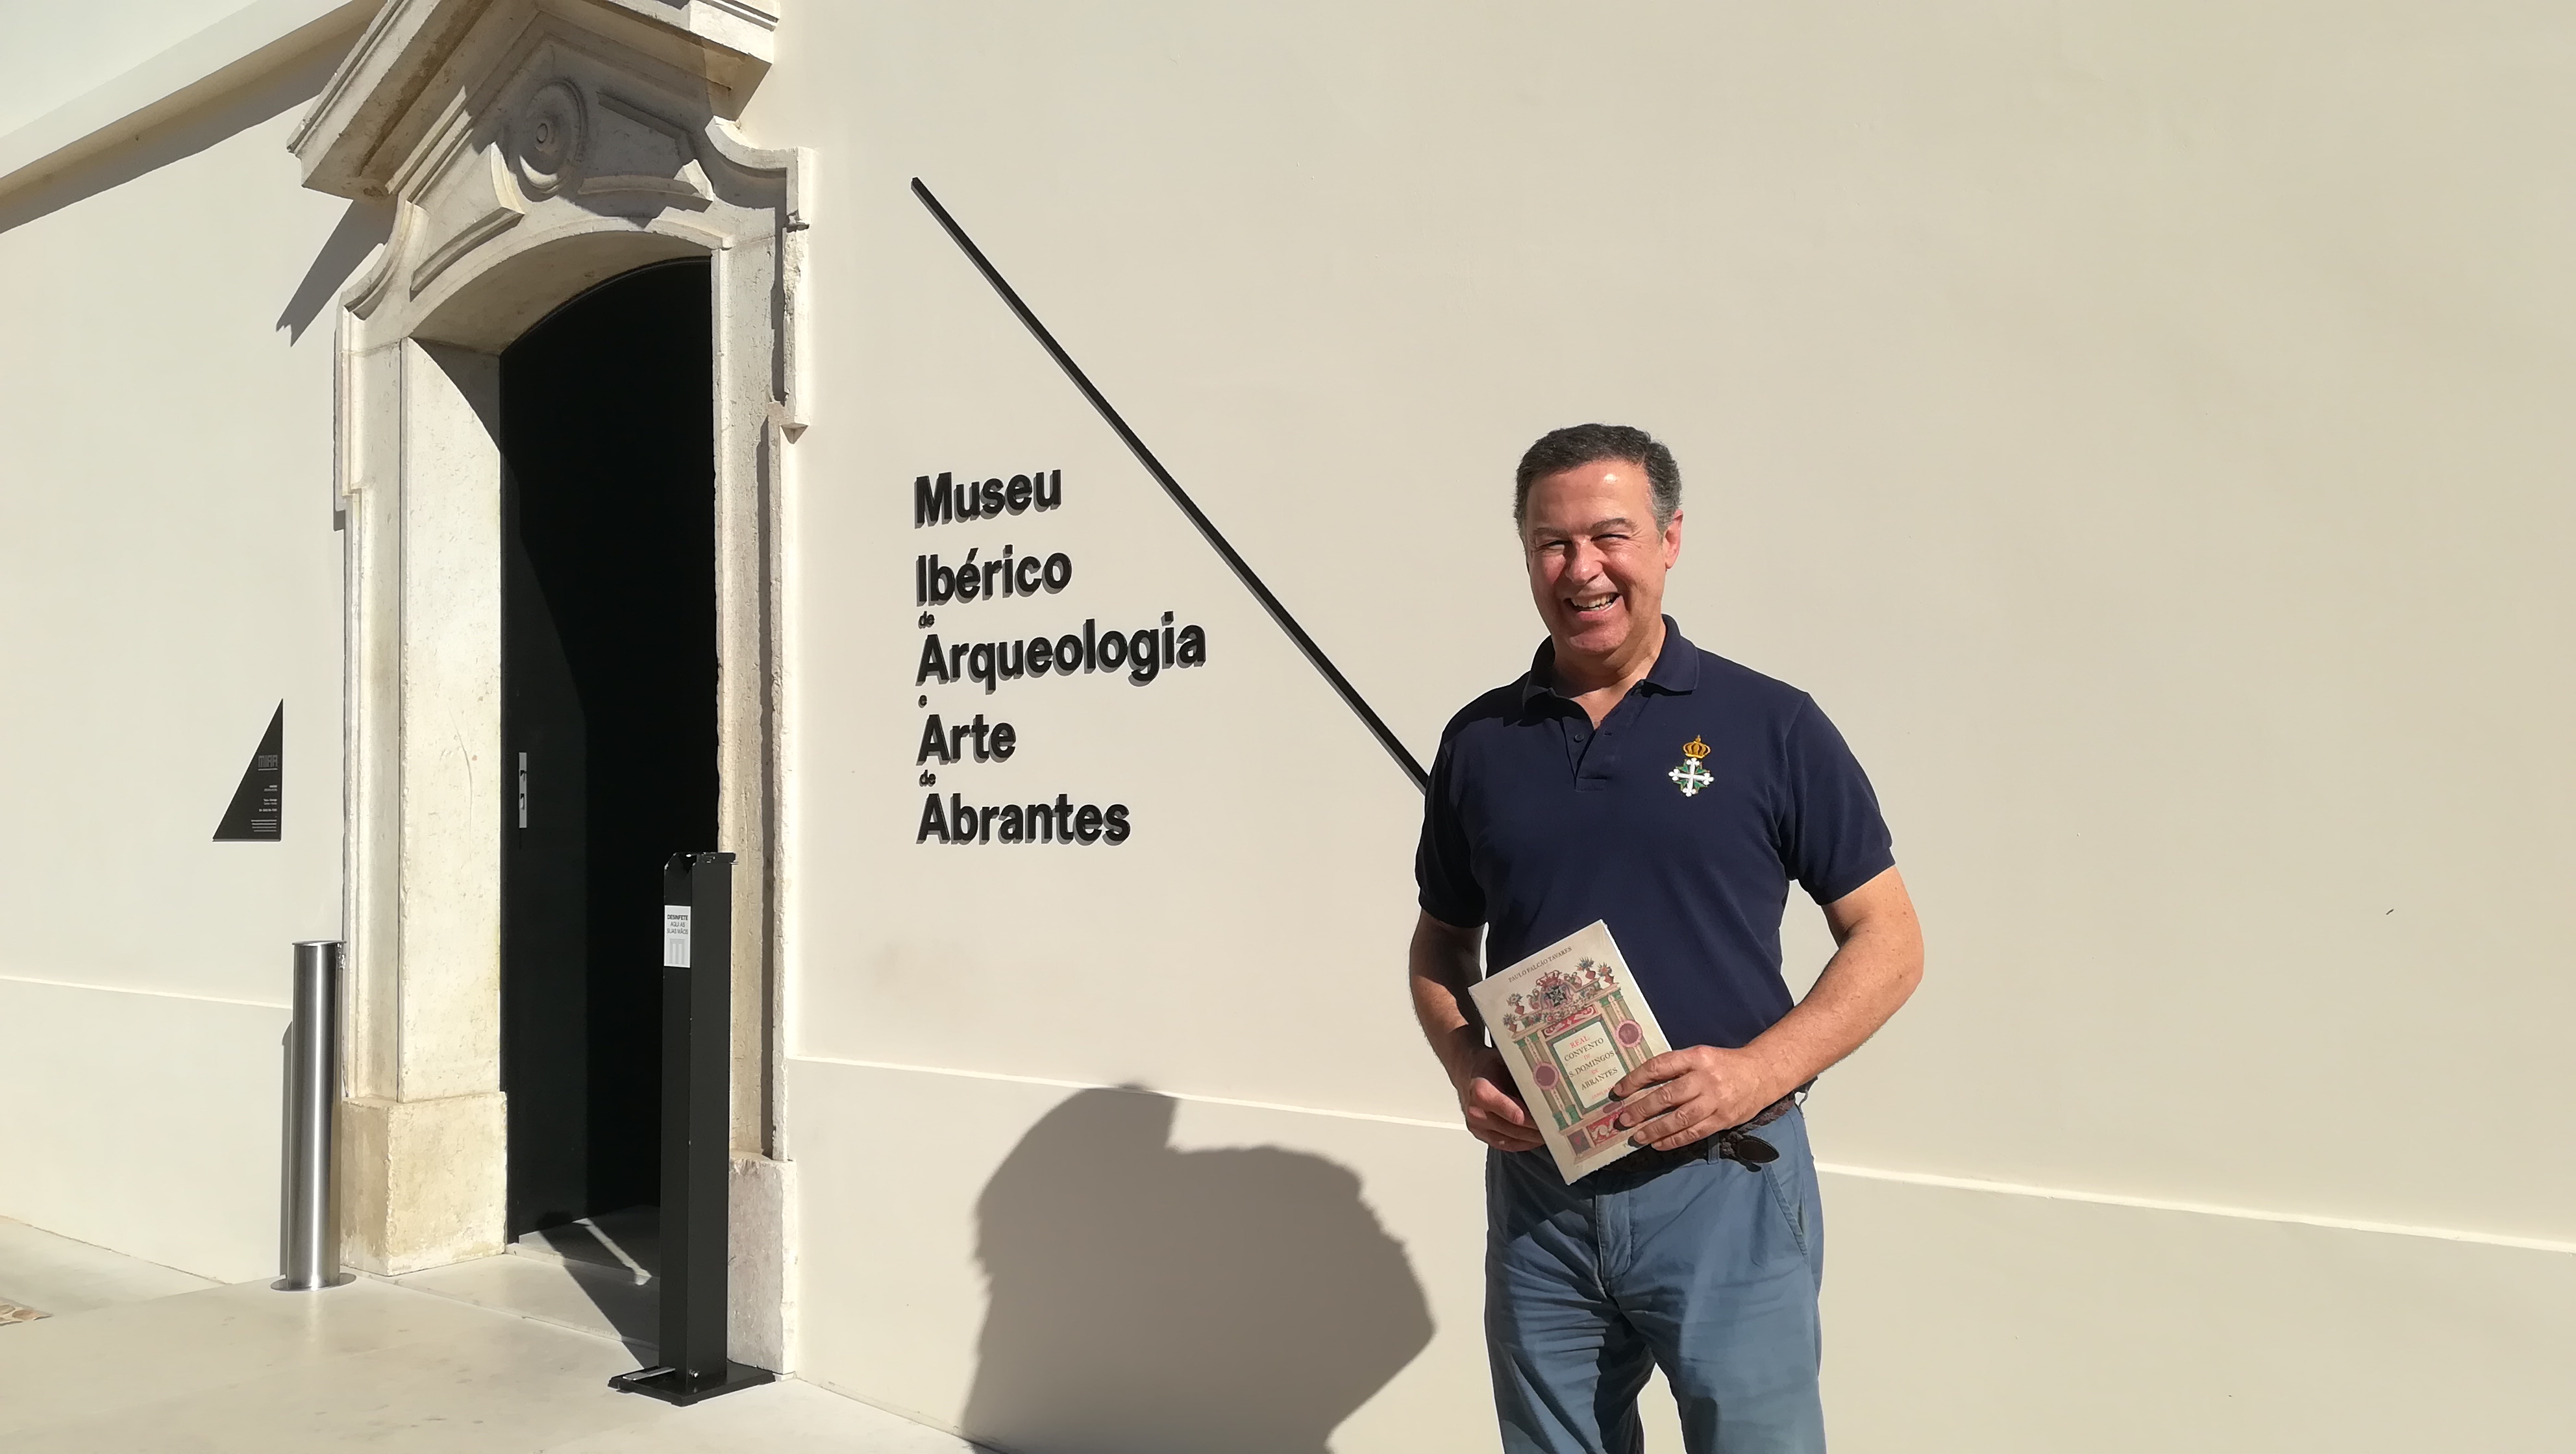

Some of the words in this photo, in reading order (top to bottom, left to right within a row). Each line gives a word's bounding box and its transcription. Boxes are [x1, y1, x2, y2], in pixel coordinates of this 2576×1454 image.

[915, 469, 1061, 528] Museu
[916, 544, 1072, 606] Ibérico
[918, 611, 935, 629] de
[915, 610, 1206, 695] Arqueologia
[918, 695, 928, 708] e
[916, 714, 1016, 765] Arte
[919, 769, 936, 787] de
[916, 793, 1131, 846] Abrantes
[1508, 970, 1527, 983] PAULO
[1526, 959, 1548, 974] FALCÃO
[1548, 946, 1572, 962] TAVARES
[1564, 1037, 1604, 1062] CONVENTO
[1570, 1035, 1590, 1048] REAL
[1574, 1050, 1615, 1075] DOMINGOS
[1581, 1067, 1618, 1090] ABRANTES
